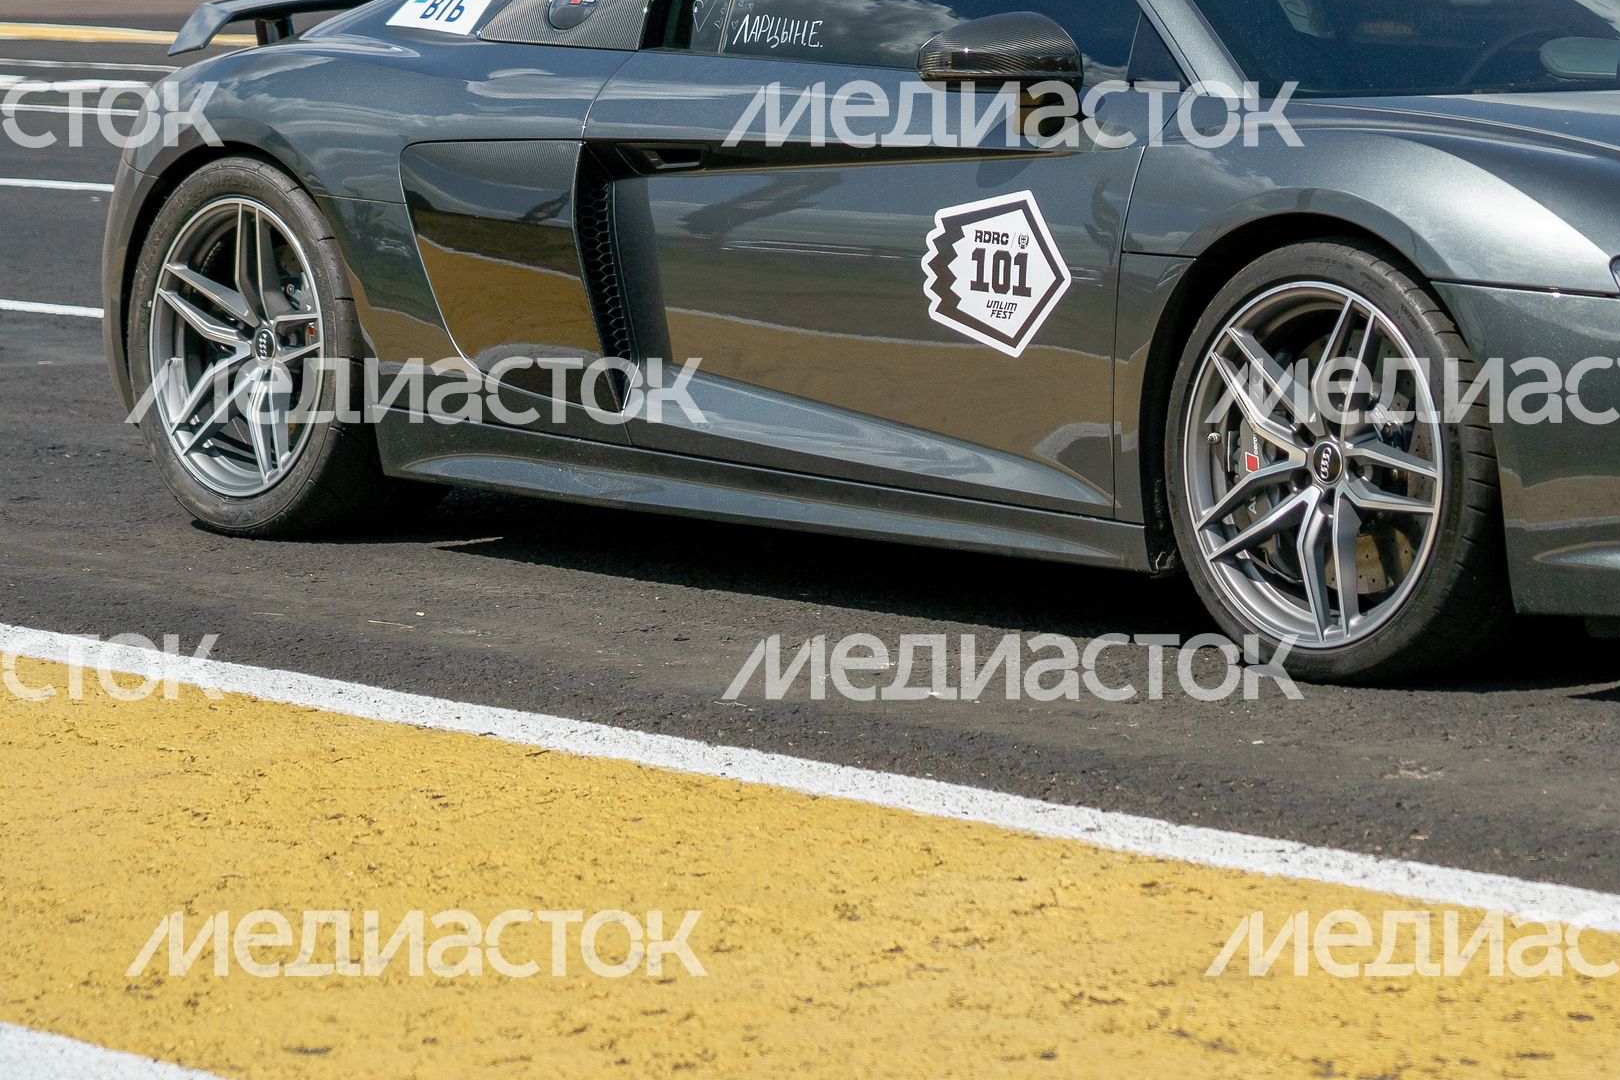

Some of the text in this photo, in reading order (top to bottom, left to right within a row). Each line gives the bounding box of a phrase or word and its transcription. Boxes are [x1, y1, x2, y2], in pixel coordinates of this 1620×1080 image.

[974, 229, 1010, 246] RDRC
[970, 247, 1032, 298] 101
[990, 309, 1014, 320] FEST
